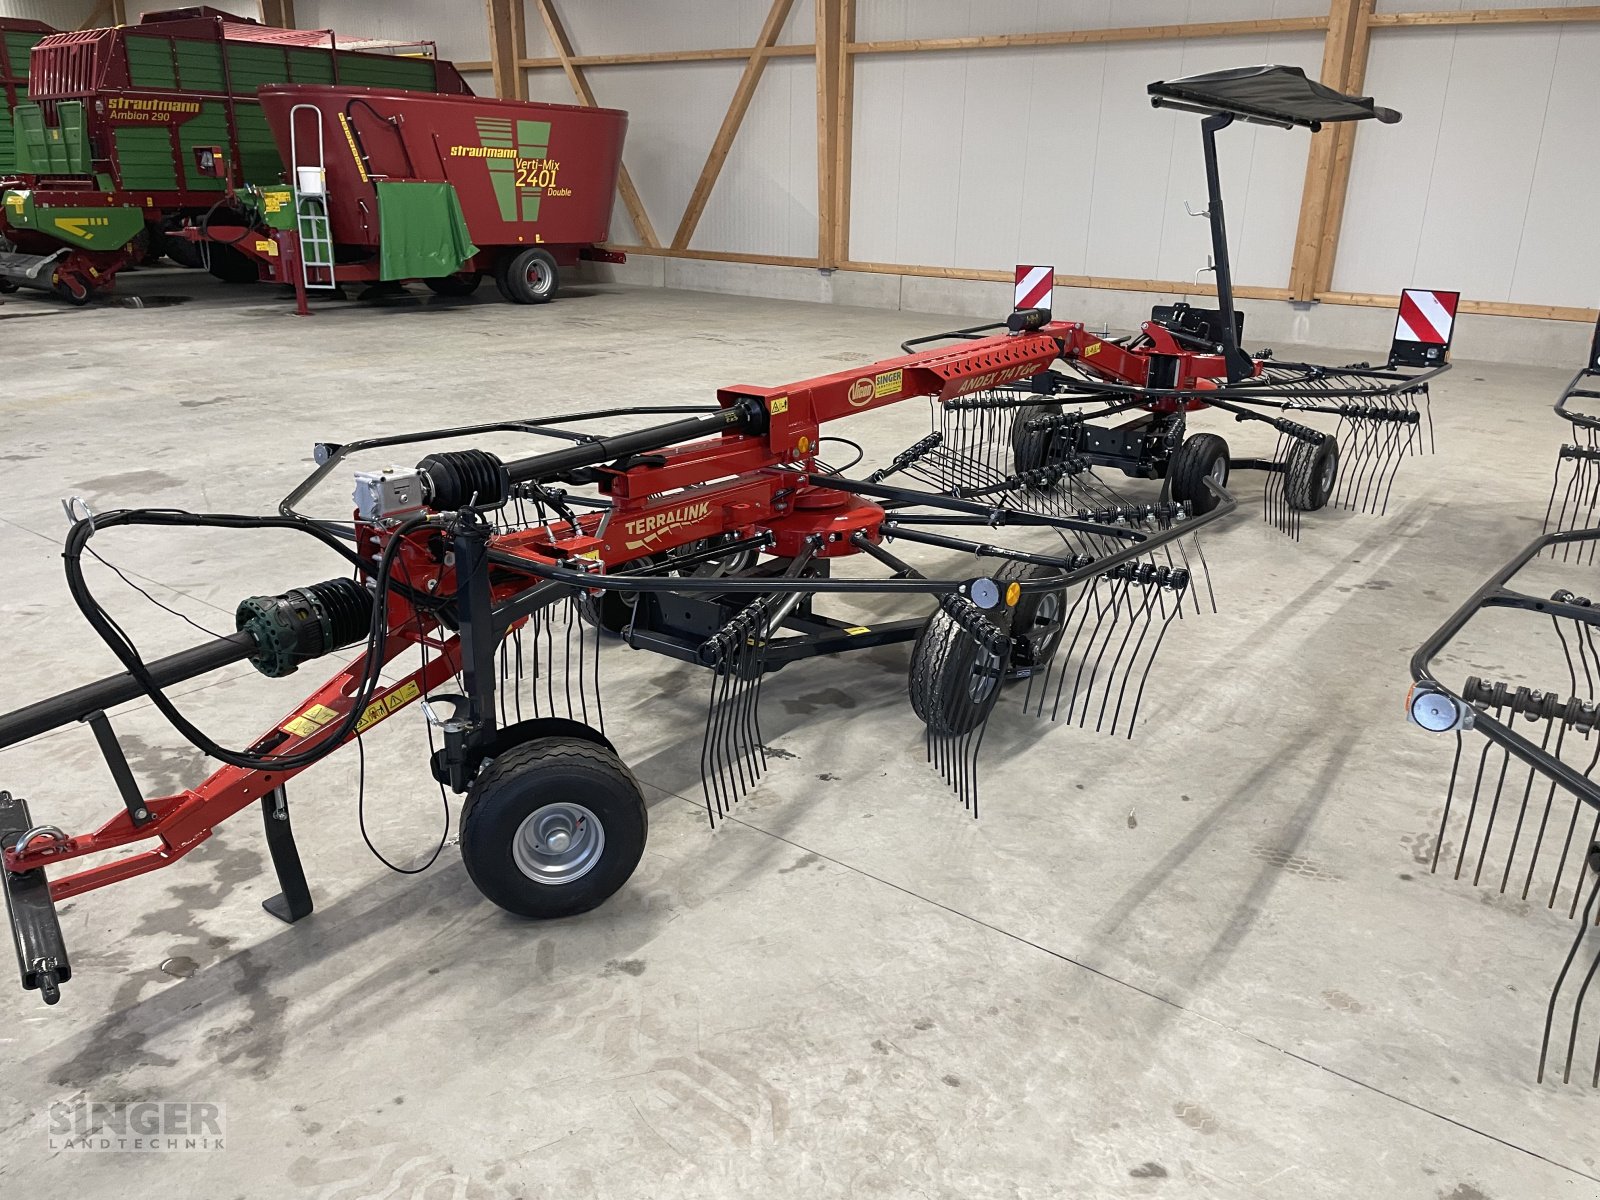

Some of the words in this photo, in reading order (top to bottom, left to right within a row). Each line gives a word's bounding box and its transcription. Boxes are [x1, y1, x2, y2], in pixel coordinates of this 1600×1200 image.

[108, 97, 200, 113] strautmann
[110, 110, 149, 120] Ambion
[151, 112, 170, 121] 290
[450, 145, 518, 159] strautmann
[515, 157, 561, 171] Verti-Mix
[515, 169, 557, 188] 2401
[547, 187, 572, 197] Double
[876, 371, 902, 386] SINGER
[958, 371, 998, 393] ANDEX
[997, 367, 1014, 383] 714
[1014, 365, 1024, 378] T
[852, 383, 872, 401] Vicon
[624, 501, 710, 535] TERRALINK
